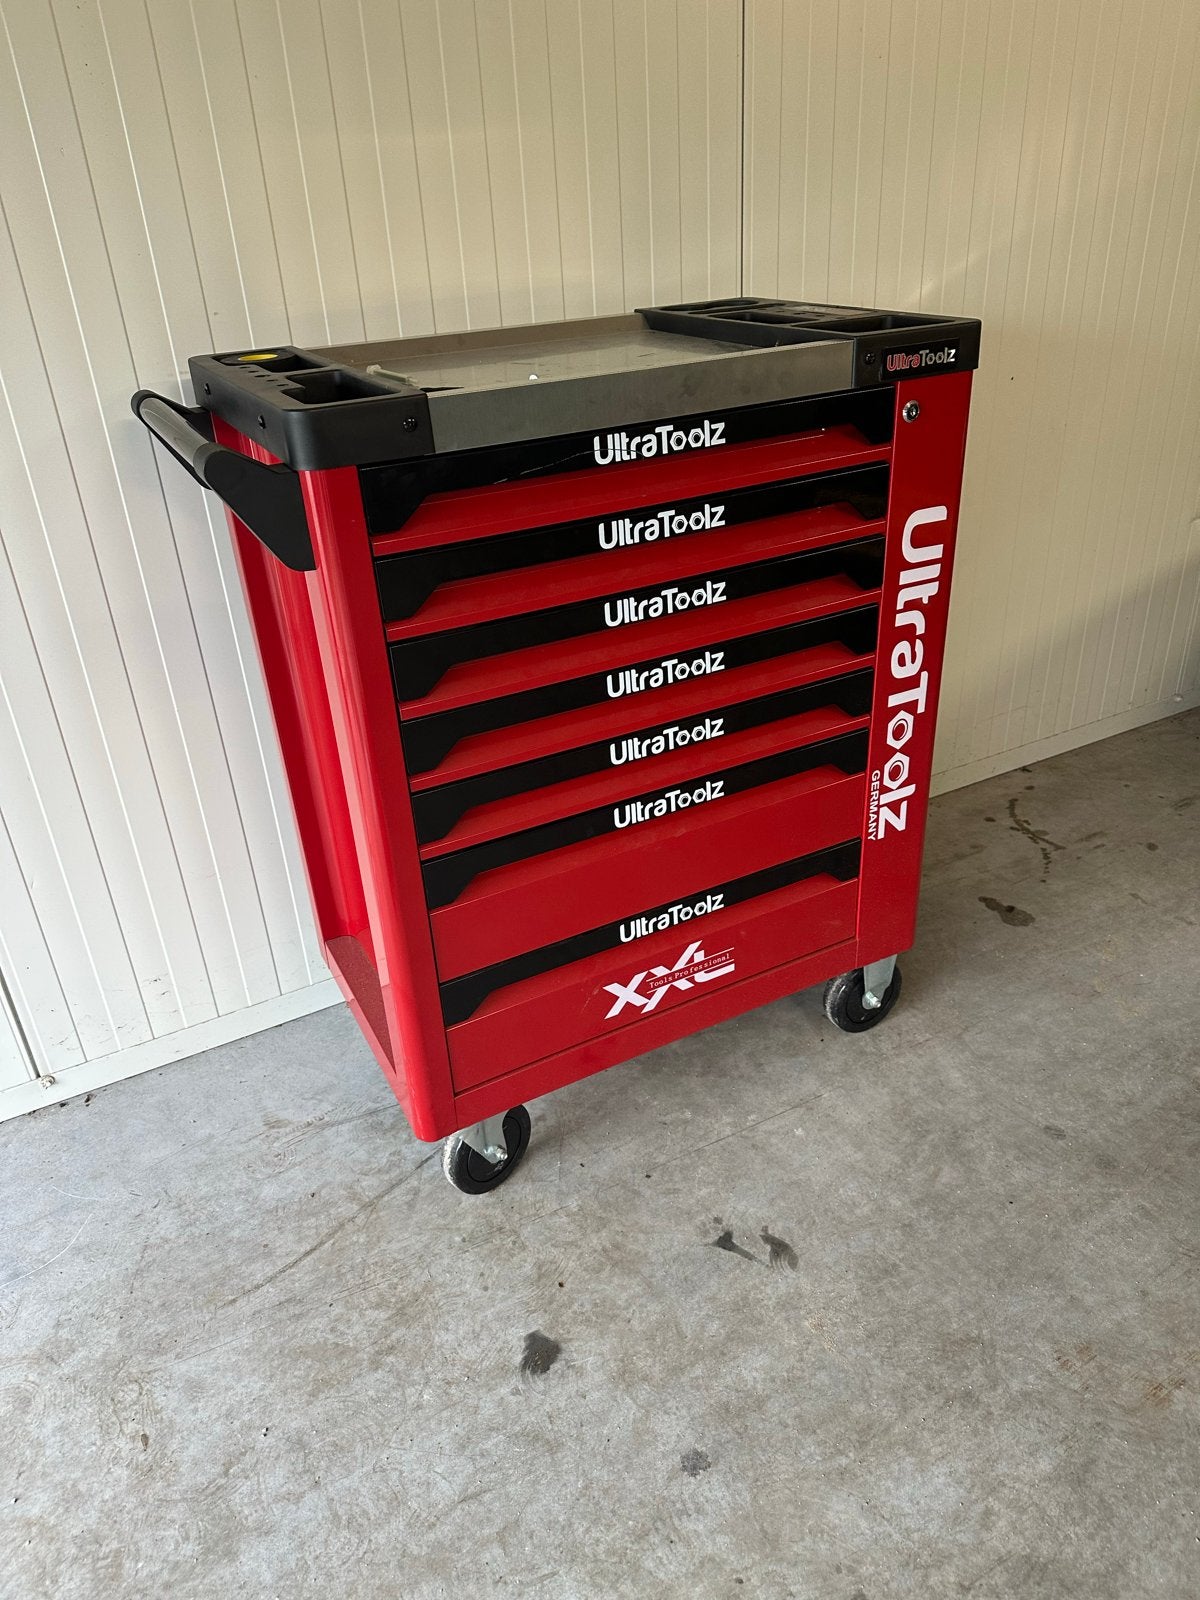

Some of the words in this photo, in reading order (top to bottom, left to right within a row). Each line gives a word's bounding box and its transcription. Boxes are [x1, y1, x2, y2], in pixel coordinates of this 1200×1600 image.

[886, 347, 956, 371] UltraToolz
[593, 419, 726, 465] UltraToolz
[598, 503, 726, 550] UltraToolz
[604, 580, 727, 627] UltraToolz
[606, 651, 725, 698] UltraToolz
[877, 505, 948, 840] UltraToolz
[609, 718, 724, 765] UltraToolz
[613, 780, 725, 828] UltraToolz
[867, 770, 880, 841] GERMANY
[619, 893, 724, 943] UltraToolz
[649, 973, 674, 989] Tools
[674, 952, 730, 981] Professional
